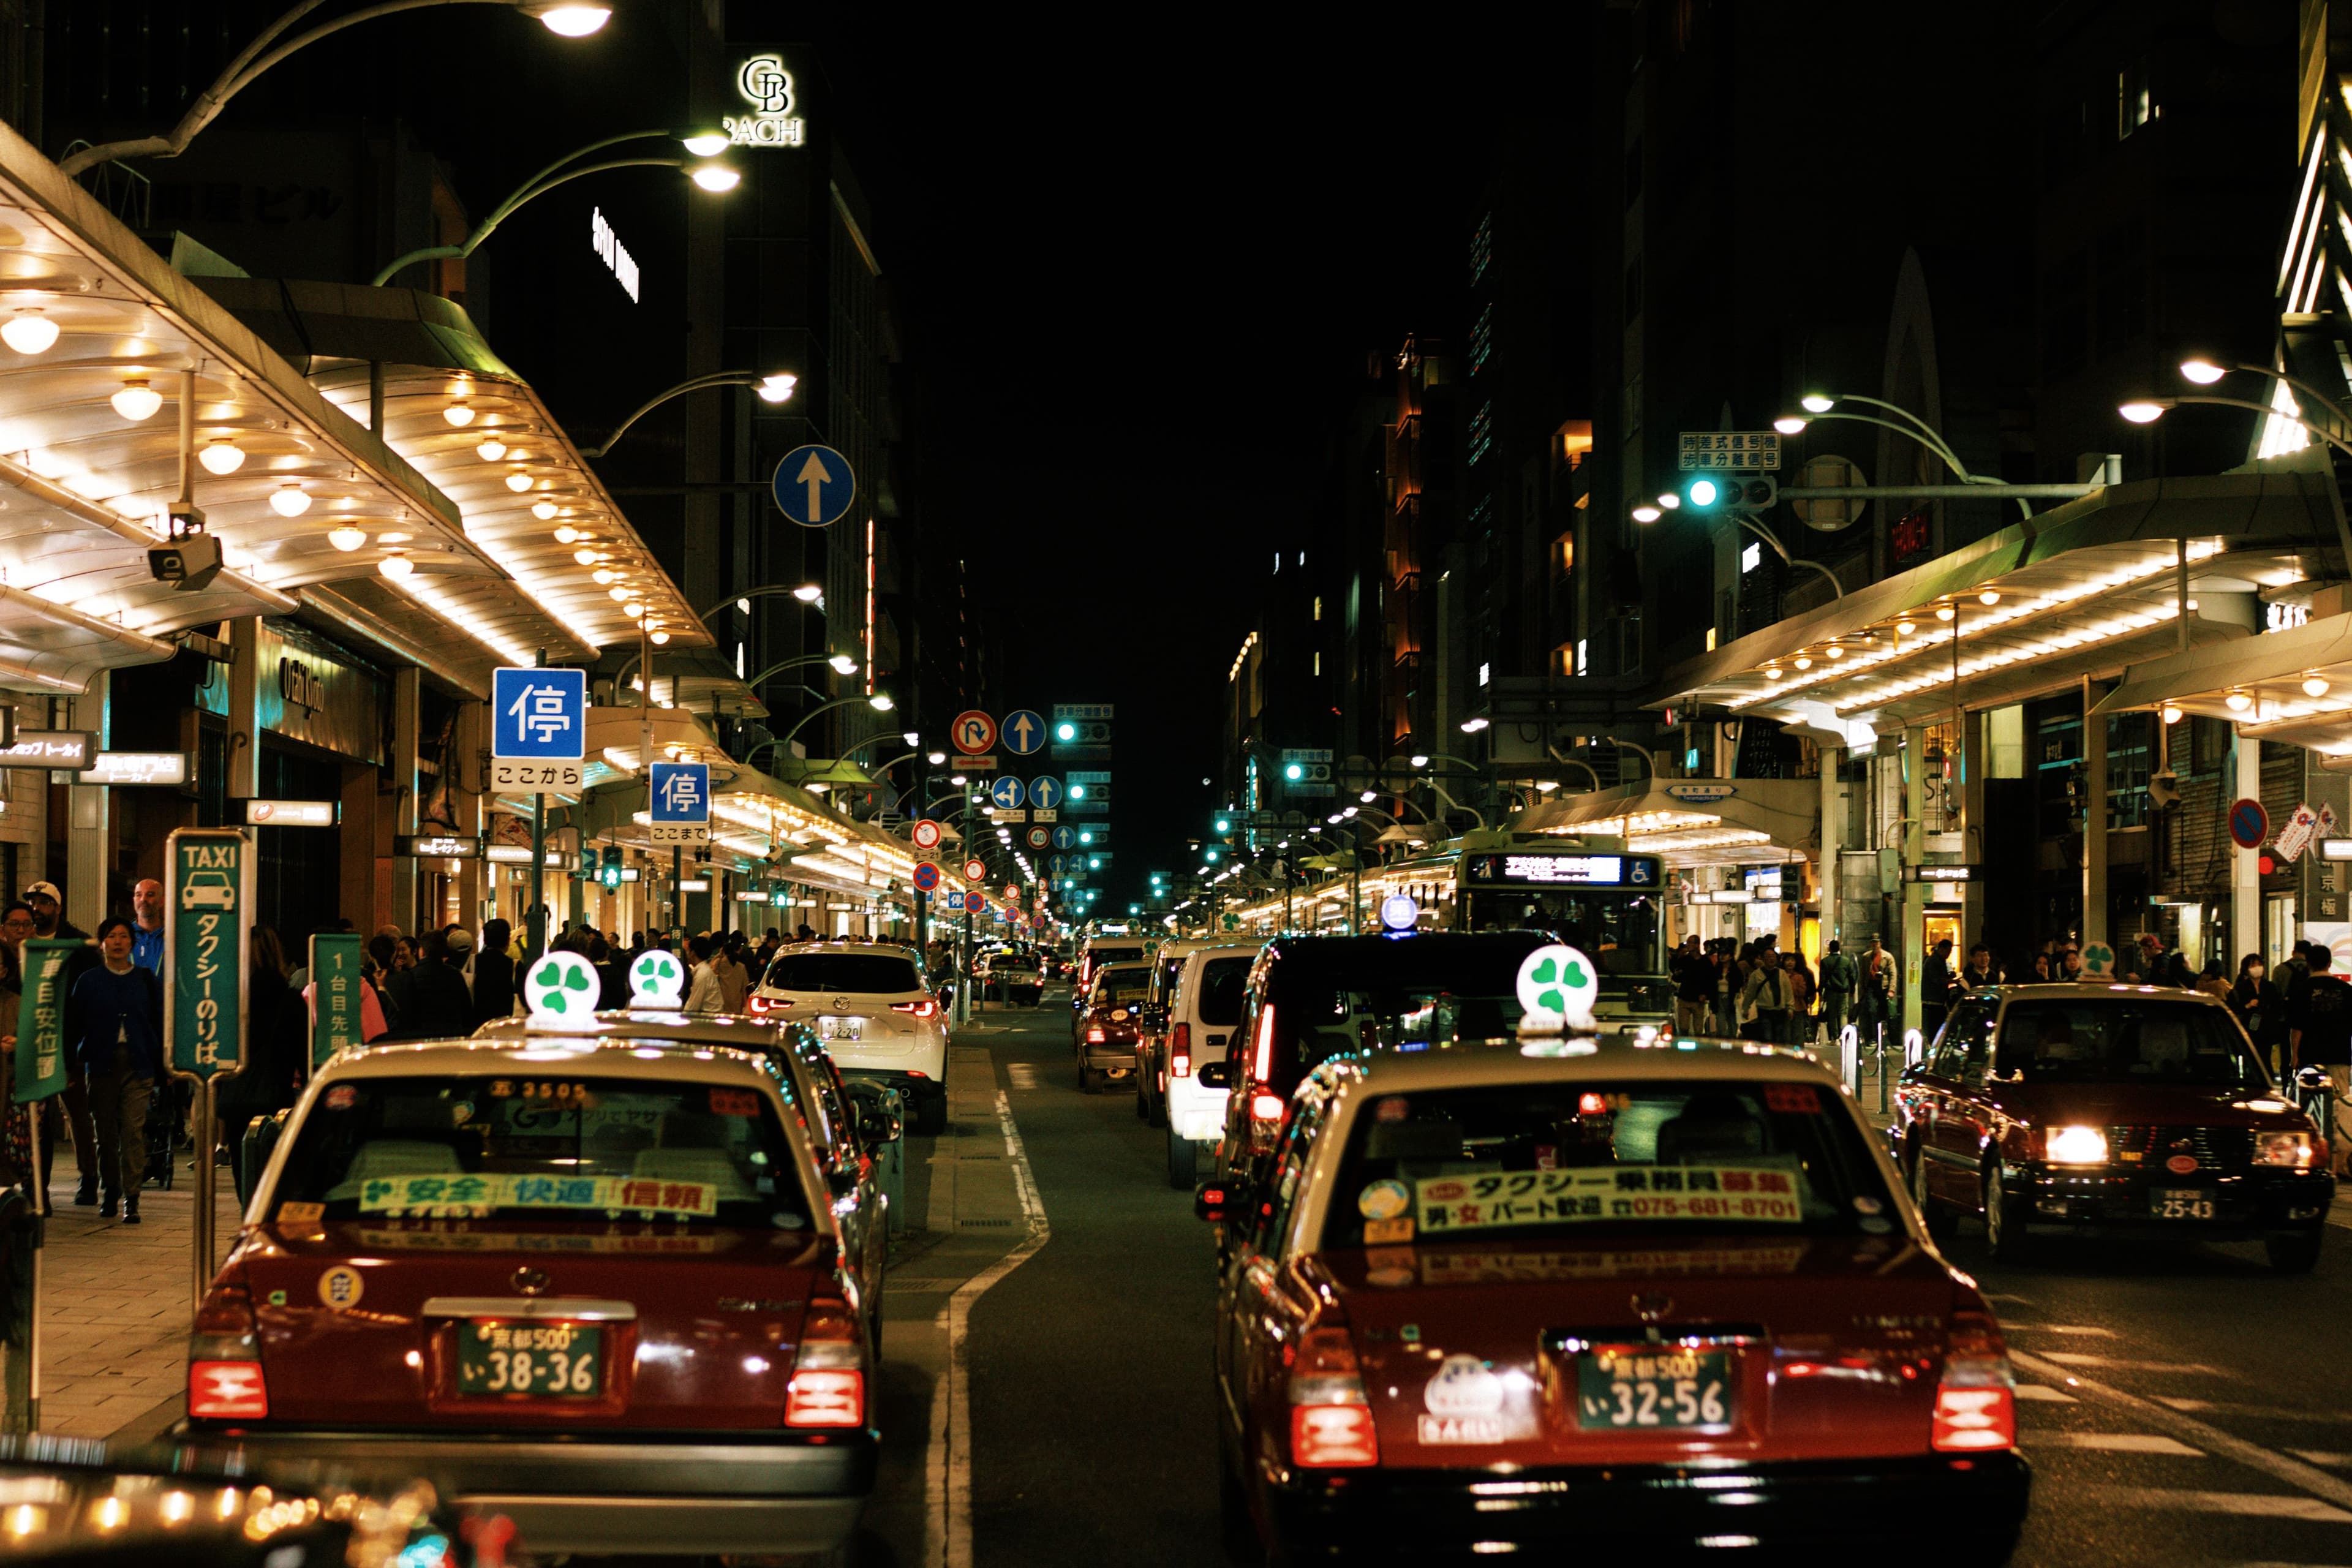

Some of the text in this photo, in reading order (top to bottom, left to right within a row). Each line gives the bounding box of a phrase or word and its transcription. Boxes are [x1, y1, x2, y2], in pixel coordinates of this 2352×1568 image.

[1683, 435, 1776, 449] 時差式信号機
[1683, 453, 1776, 467] 歩車分離信号
[508, 683, 571, 743] 停
[497, 767, 579, 785] ここから
[660, 773, 700, 812] 停
[653, 827, 707, 840] ここまで
[1033, 832, 1046, 843] 40
[183, 846, 236, 869] TAXI
[2321, 862, 2336, 916] 京極
[195, 914, 220, 1065] タクシーのりば
[2162, 1200, 2214, 1219] 25-43
[492, 1329, 570, 1351] 京都500
[487, 1351, 594, 1391] 38-36
[1610, 1381, 1724, 1425] 32-56
